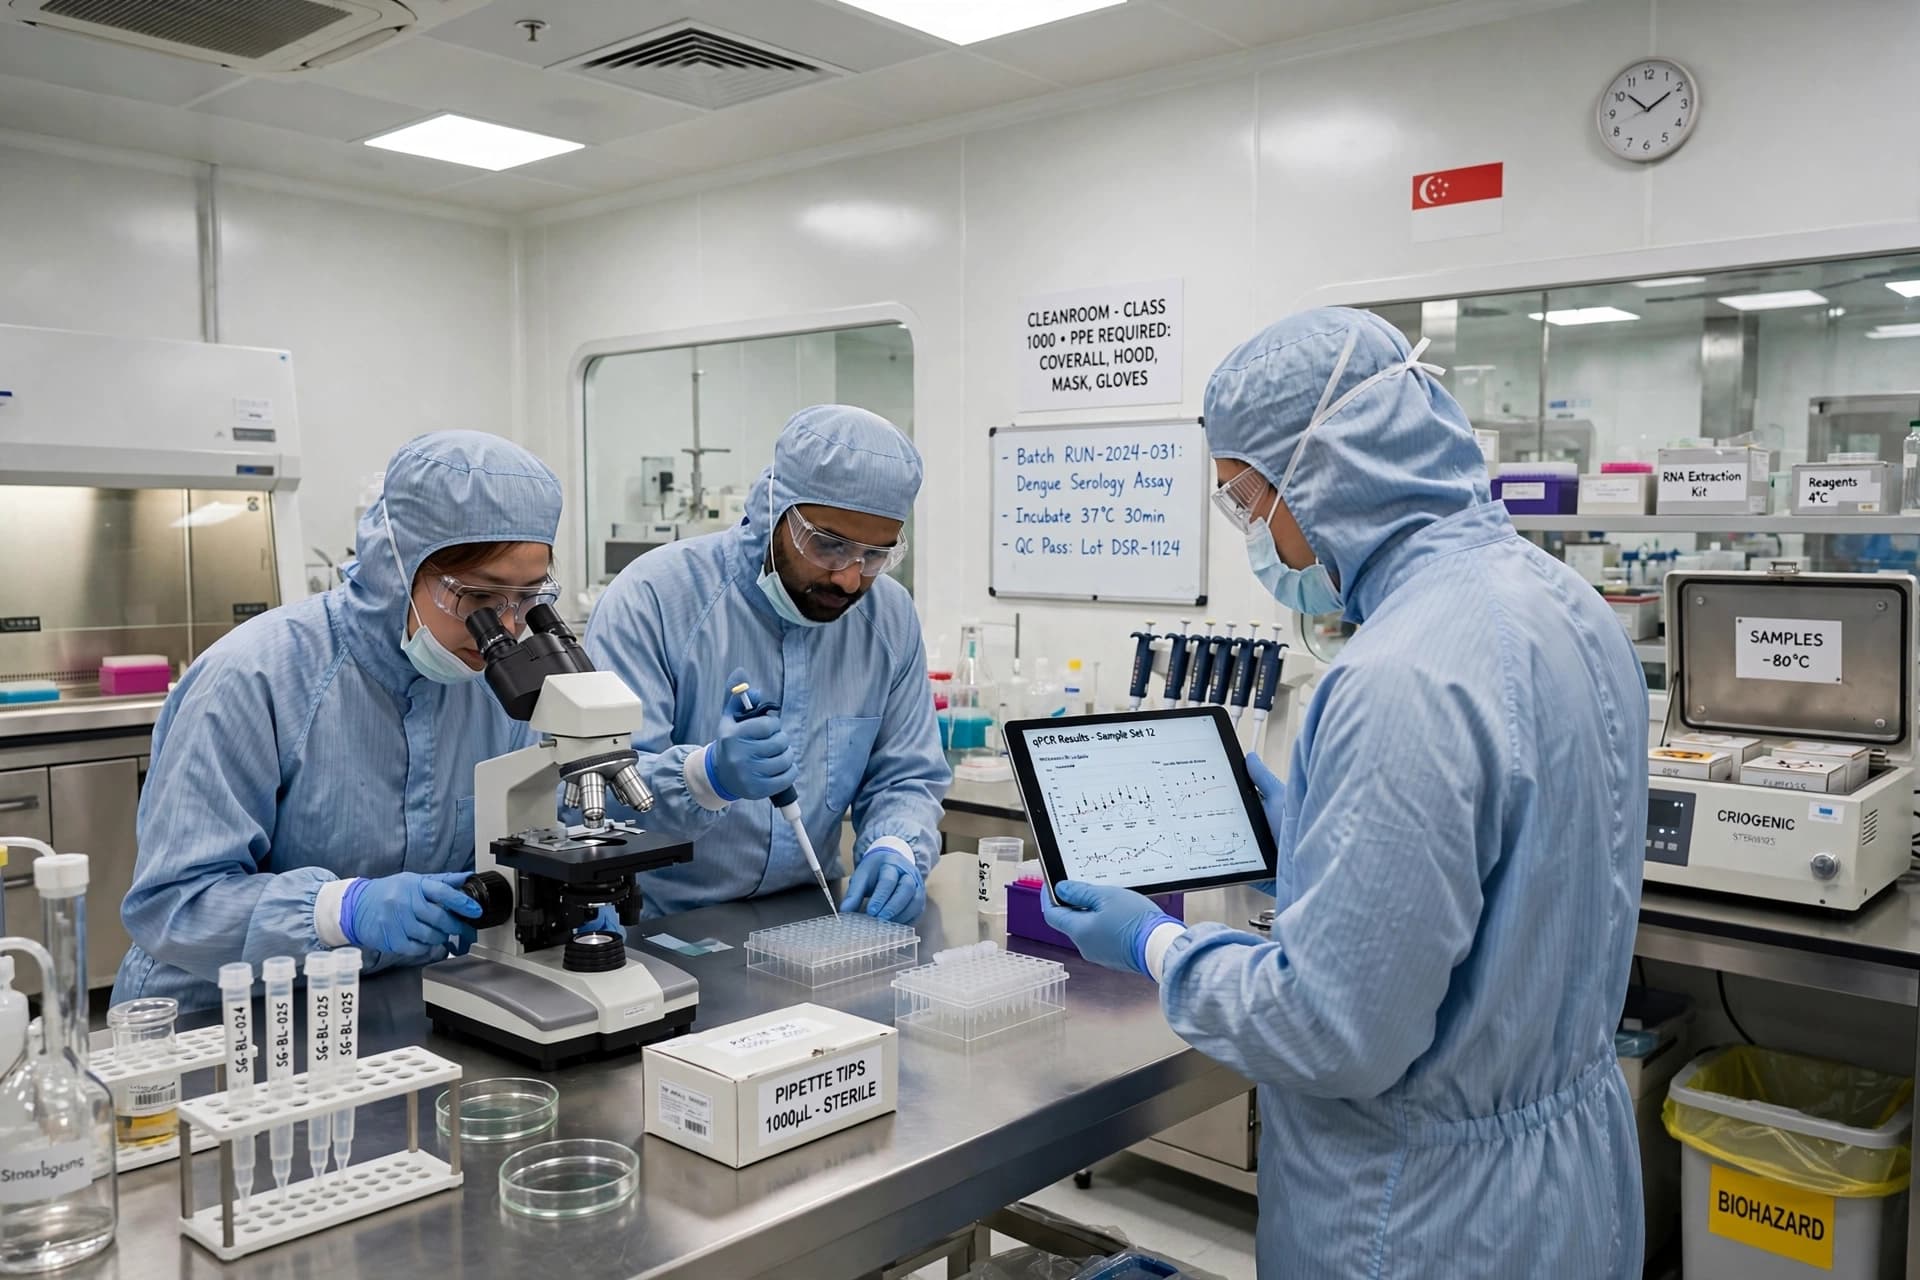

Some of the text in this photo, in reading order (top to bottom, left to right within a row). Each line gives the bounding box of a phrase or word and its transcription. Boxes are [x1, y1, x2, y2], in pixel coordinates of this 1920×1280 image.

[1644, 69, 1655, 81] 12
[1627, 77, 1636, 88] 11
[1675, 81, 1684, 92] 2
[1615, 91, 1626, 102] 10
[1680, 98, 1688, 110] 3
[1609, 109, 1616, 119] 9
[1674, 117, 1682, 127] 4
[1613, 126, 1620, 137] 8
[1661, 132, 1669, 143] 5
[1626, 137, 1633, 148] 7
[1643, 140, 1650, 150] 6
[1027, 304, 1110, 327] CLEANROOM
[1123, 298, 1166, 317] CLASS
[1027, 332, 1056, 350] 1000
[1070, 329, 1094, 345] PPE
[1099, 322, 1171, 343] REQUIRED:
[1039, 346, 1158, 370] COVERALL, HOOD,
[1052, 370, 1148, 392] MASK, GLOVES
[1017, 446, 1054, 466] Batch
[1065, 443, 1183, 463] RUN-2024-031:
[1663, 470, 1742, 483] RNA Extraction
[1809, 477, 1858, 489] Reagents
[1017, 471, 1173, 498] Dengue Serology Assay
[1691, 486, 1707, 497] Kit
[1808, 491, 1828, 503] 4°C
[1015, 506, 1072, 524] Incubate
[1081, 505, 1115, 523] 37°C
[1124, 508, 1165, 523] 30min
[1015, 536, 1034, 555] QC
[1042, 536, 1072, 555] Pass:
[1081, 538, 1104, 555] Lot
[1111, 538, 1181, 557] DSR-1124
[1750, 630, 1824, 647] SAMPLES
[1762, 653, 1810, 669] -80°C
[1032, 735, 1057, 748] qPCR
[1057, 733, 1090, 744] Results
[1096, 729, 1128, 742] Sample
[1129, 728, 1144, 738] Set
[1146, 728, 1156, 737] 12
[1717, 809, 1796, 831] CRIOGENIC
[775, 1060, 866, 1105] PIPETTE TIPS
[824, 1081, 876, 1114] STERILE
[1718, 1190, 1825, 1241] BIOHAZARD
